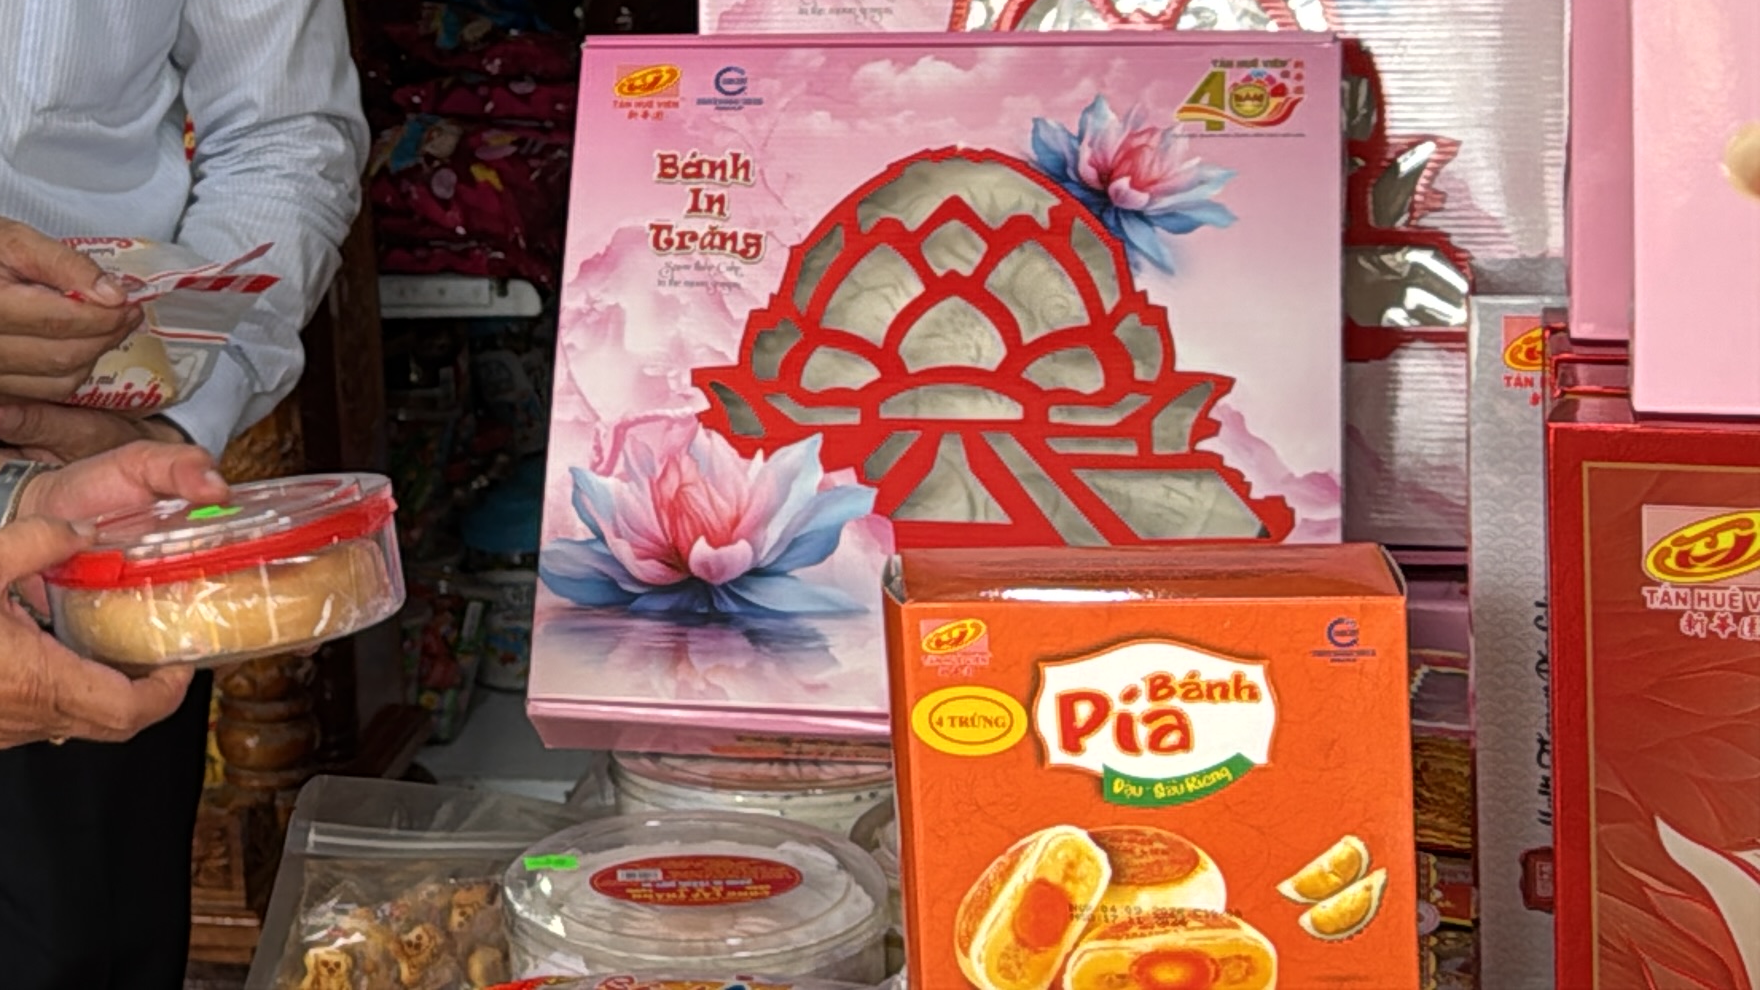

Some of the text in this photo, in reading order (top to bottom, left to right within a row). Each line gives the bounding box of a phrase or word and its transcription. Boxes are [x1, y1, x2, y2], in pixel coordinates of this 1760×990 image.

[655, 151, 754, 183] Bánh
[687, 187, 728, 218] In
[1645, 584, 1689, 607] TÂN
[1696, 586, 1741, 609] HUÊ
[1147, 671, 1260, 702] Bánh
[935, 715, 944, 728] 4
[1057, 685, 1193, 754] Pía
